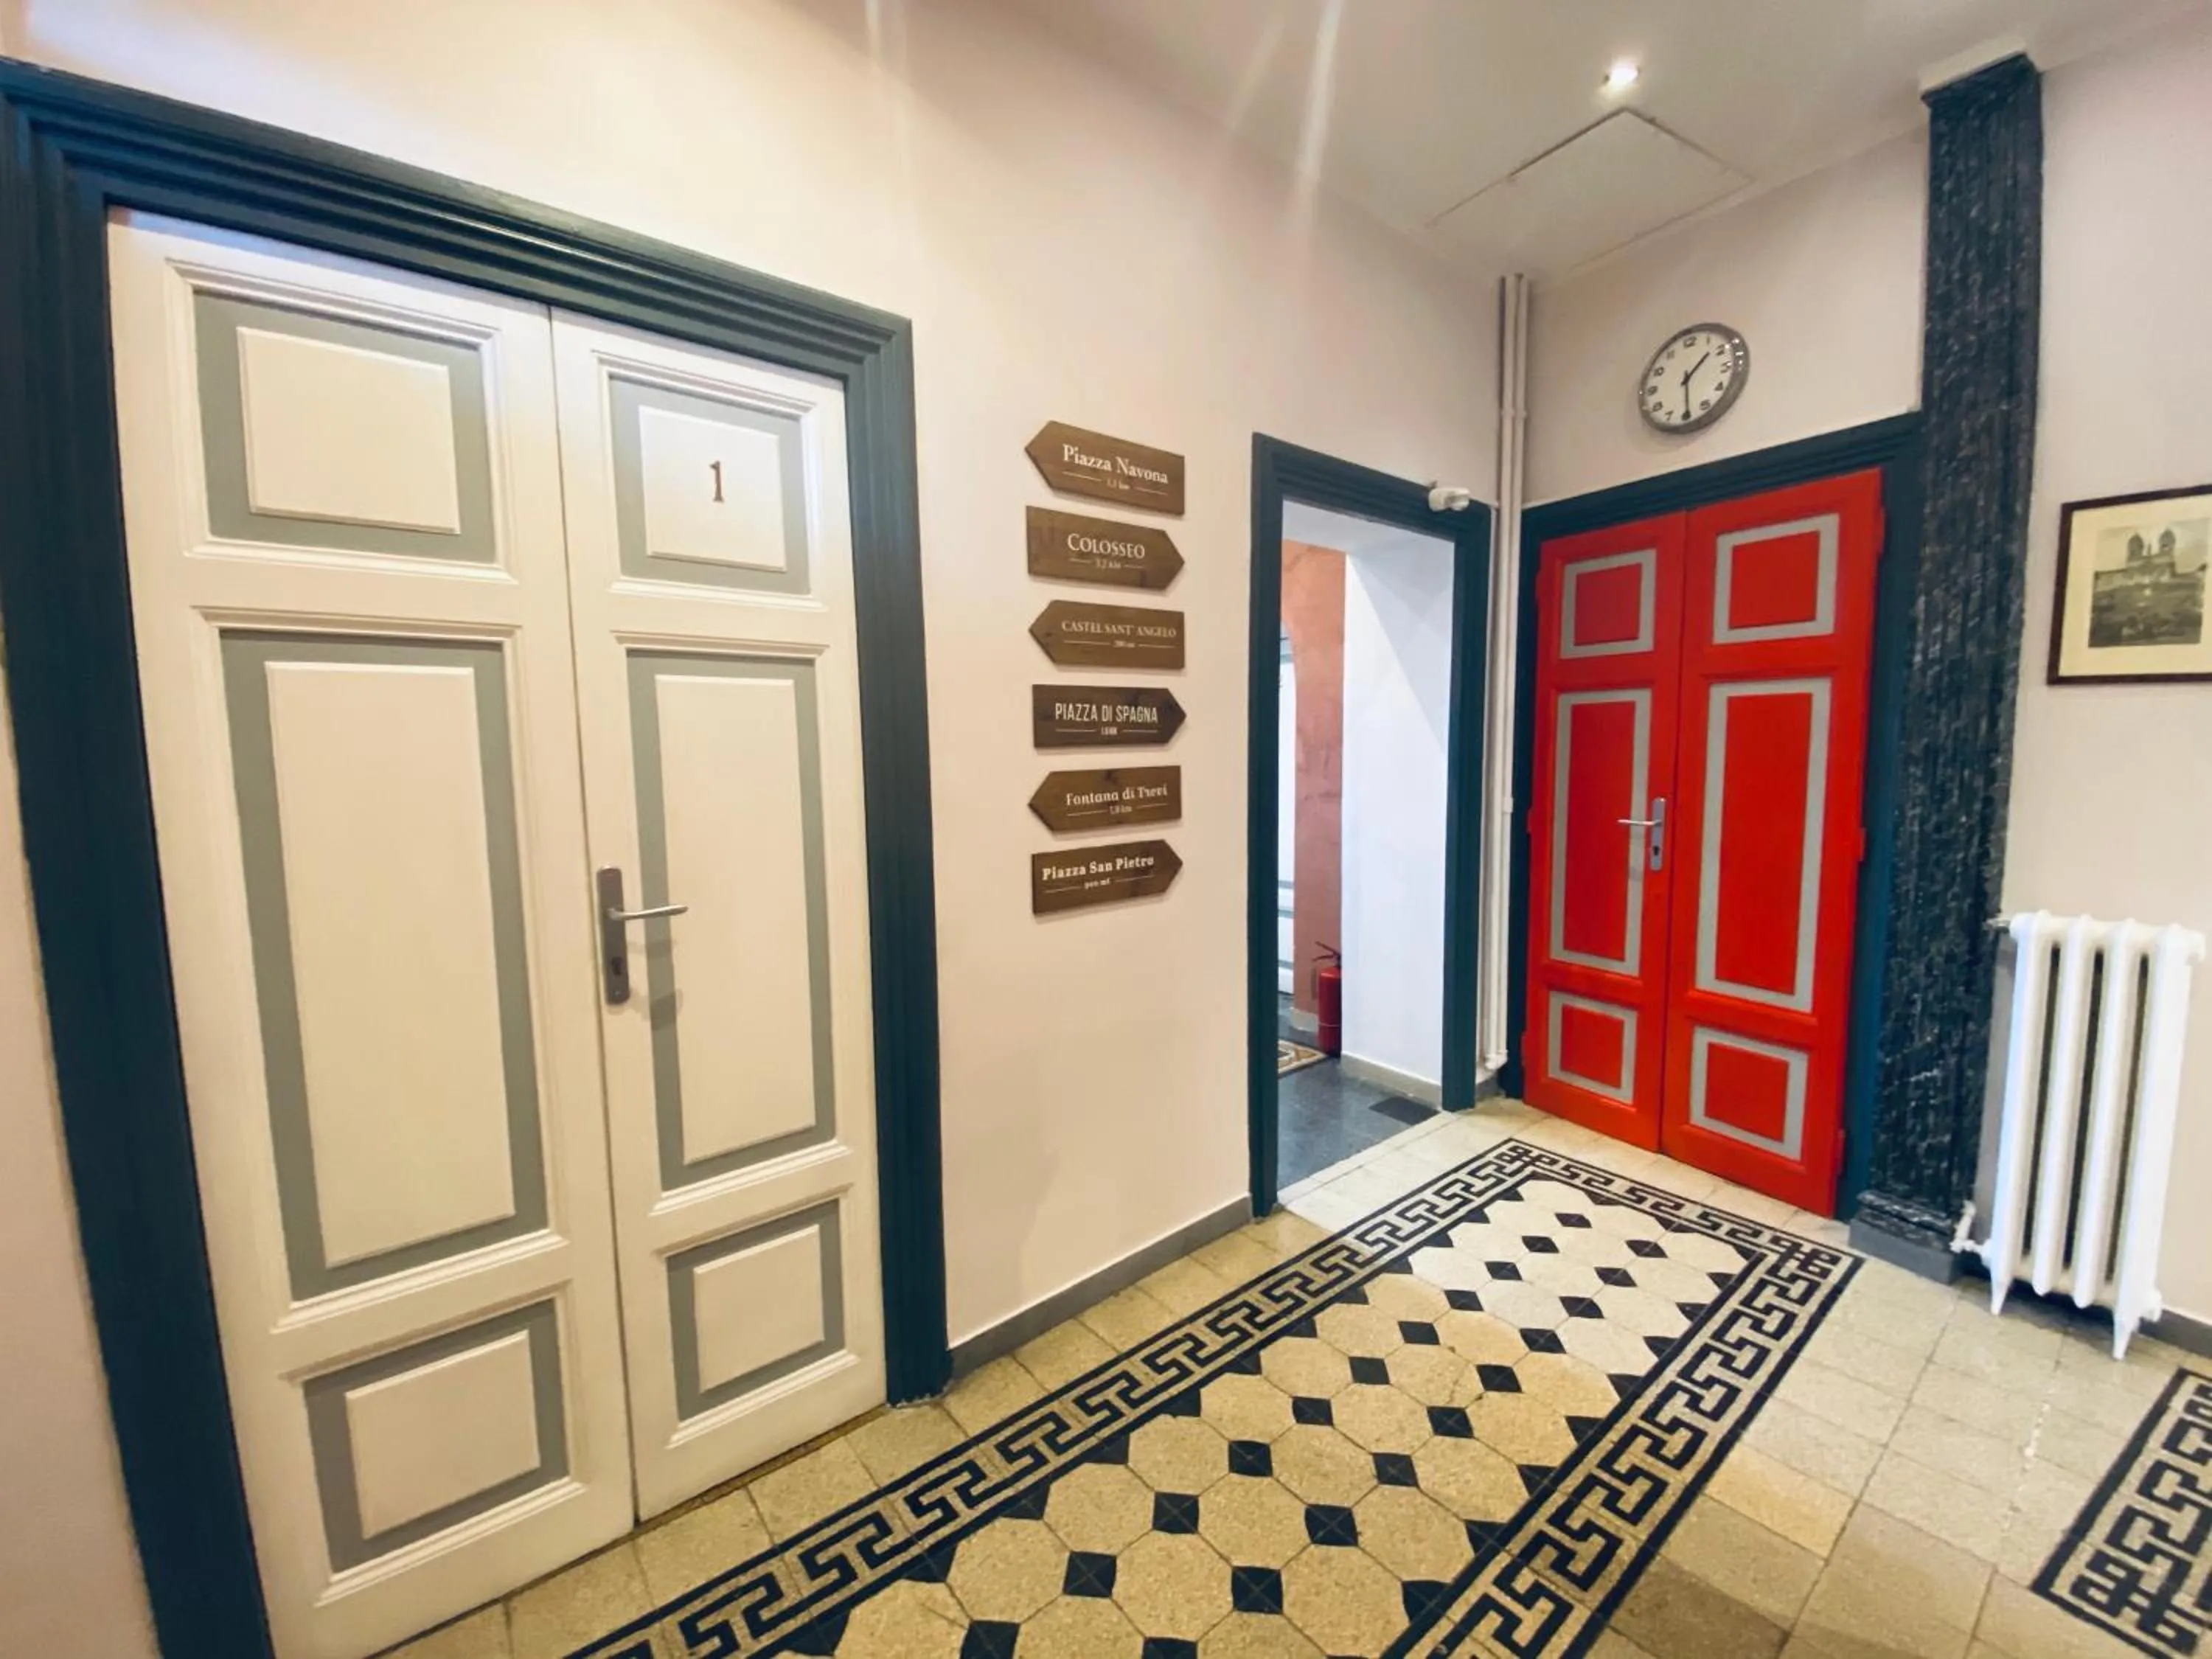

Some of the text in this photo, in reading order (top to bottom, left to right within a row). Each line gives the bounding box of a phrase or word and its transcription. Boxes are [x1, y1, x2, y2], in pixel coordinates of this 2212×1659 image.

[1716, 344, 1725, 355] 2
[1062, 444, 1169, 484] Piazza Navona
[709, 460, 725, 504] 1
[1067, 533, 1145, 559] COLOSSEO
[1062, 620, 1105, 633] CASTEL
[1136, 627, 1177, 638] ANGELO
[1055, 703, 1158, 723] PIAZZA DI SPAGNA
[1066, 784, 1168, 806] Fontana di Trevi
[1042, 856, 1155, 881] Piazza San Pietro
